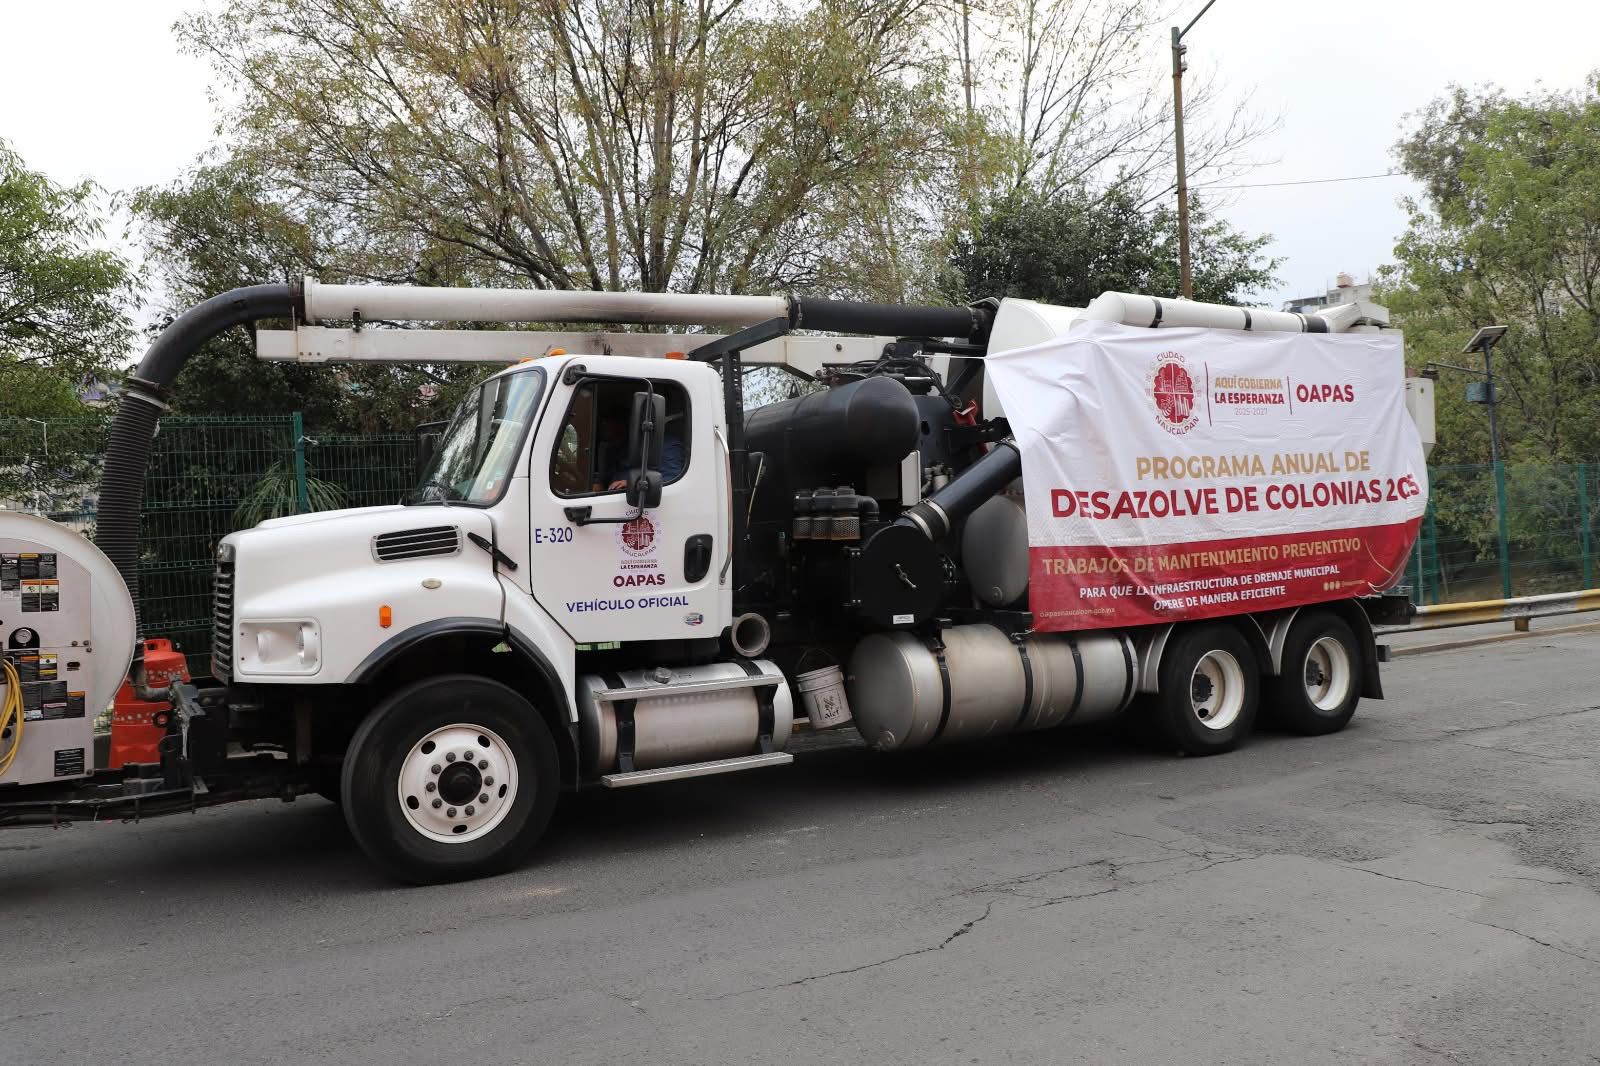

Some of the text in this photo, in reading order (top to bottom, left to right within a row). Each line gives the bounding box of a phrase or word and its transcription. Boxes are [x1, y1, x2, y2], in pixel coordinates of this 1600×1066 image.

[1156, 351, 1185, 363] CIUDAD
[1215, 375, 1283, 390] AQUÍ GOBIERNA
[1214, 392, 1285, 405] LA ESPERANZA
[1296, 384, 1354, 403] OAPAS
[1155, 415, 1200, 436] NAUCALPAN
[1136, 450, 1371, 481] PROGRAMA ANUAL DE
[1050, 488, 1219, 520] DESAZOLVE
[1225, 486, 1259, 513] DE
[1265, 479, 1382, 510] COLONIAS
[535, 526, 573, 544] E-320
[1042, 537, 1361, 575] TRABAJOS DE MANTENIMIENTO PREVENTIVO
[613, 573, 666, 587] OAPAS
[1079, 565, 1340, 599] PARA QUE LA INFRAESTRUCTURA DE DRENAJE MUNICIPAL
[566, 595, 689, 613] VEHÍCULO OFICIAL
[1153, 586, 1286, 611] OPERE DE MANERA EFICIENTE
